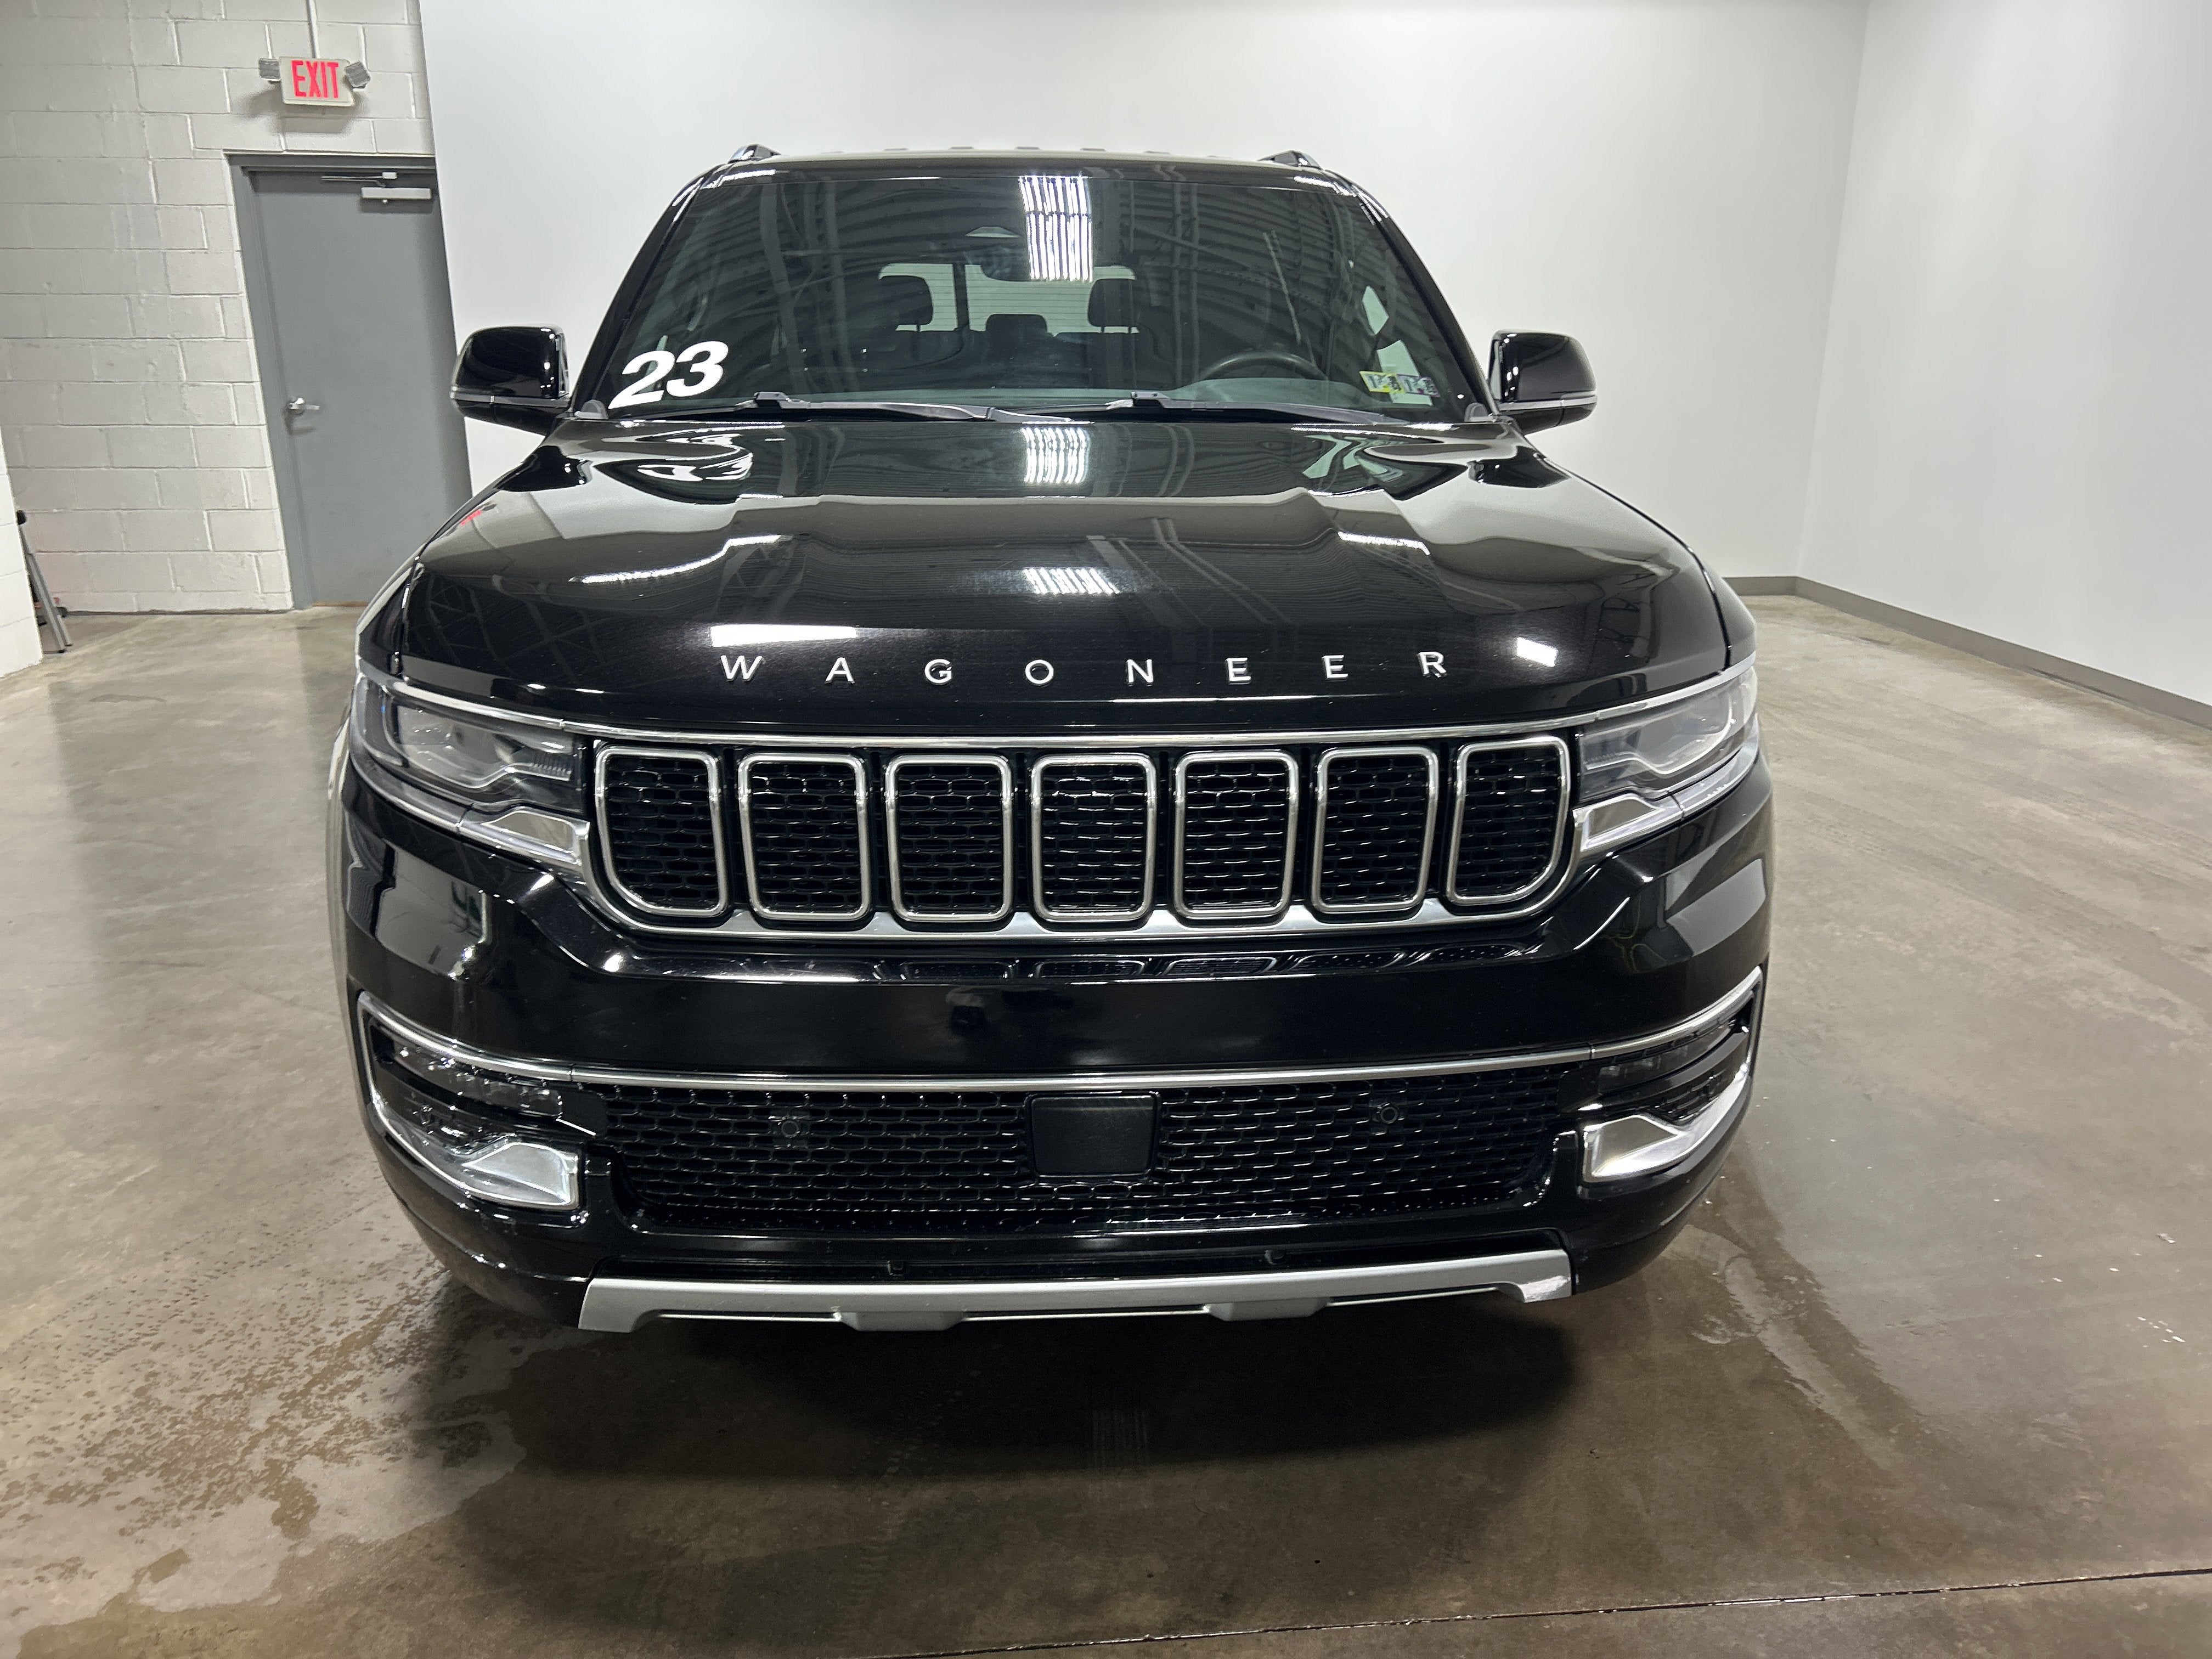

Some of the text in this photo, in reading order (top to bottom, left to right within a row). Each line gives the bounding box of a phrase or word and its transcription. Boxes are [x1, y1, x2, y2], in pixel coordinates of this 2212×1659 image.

[291, 60, 339, 98] EXIT
[608, 341, 729, 409] 23
[720, 651, 1447, 686] WAGONEER
